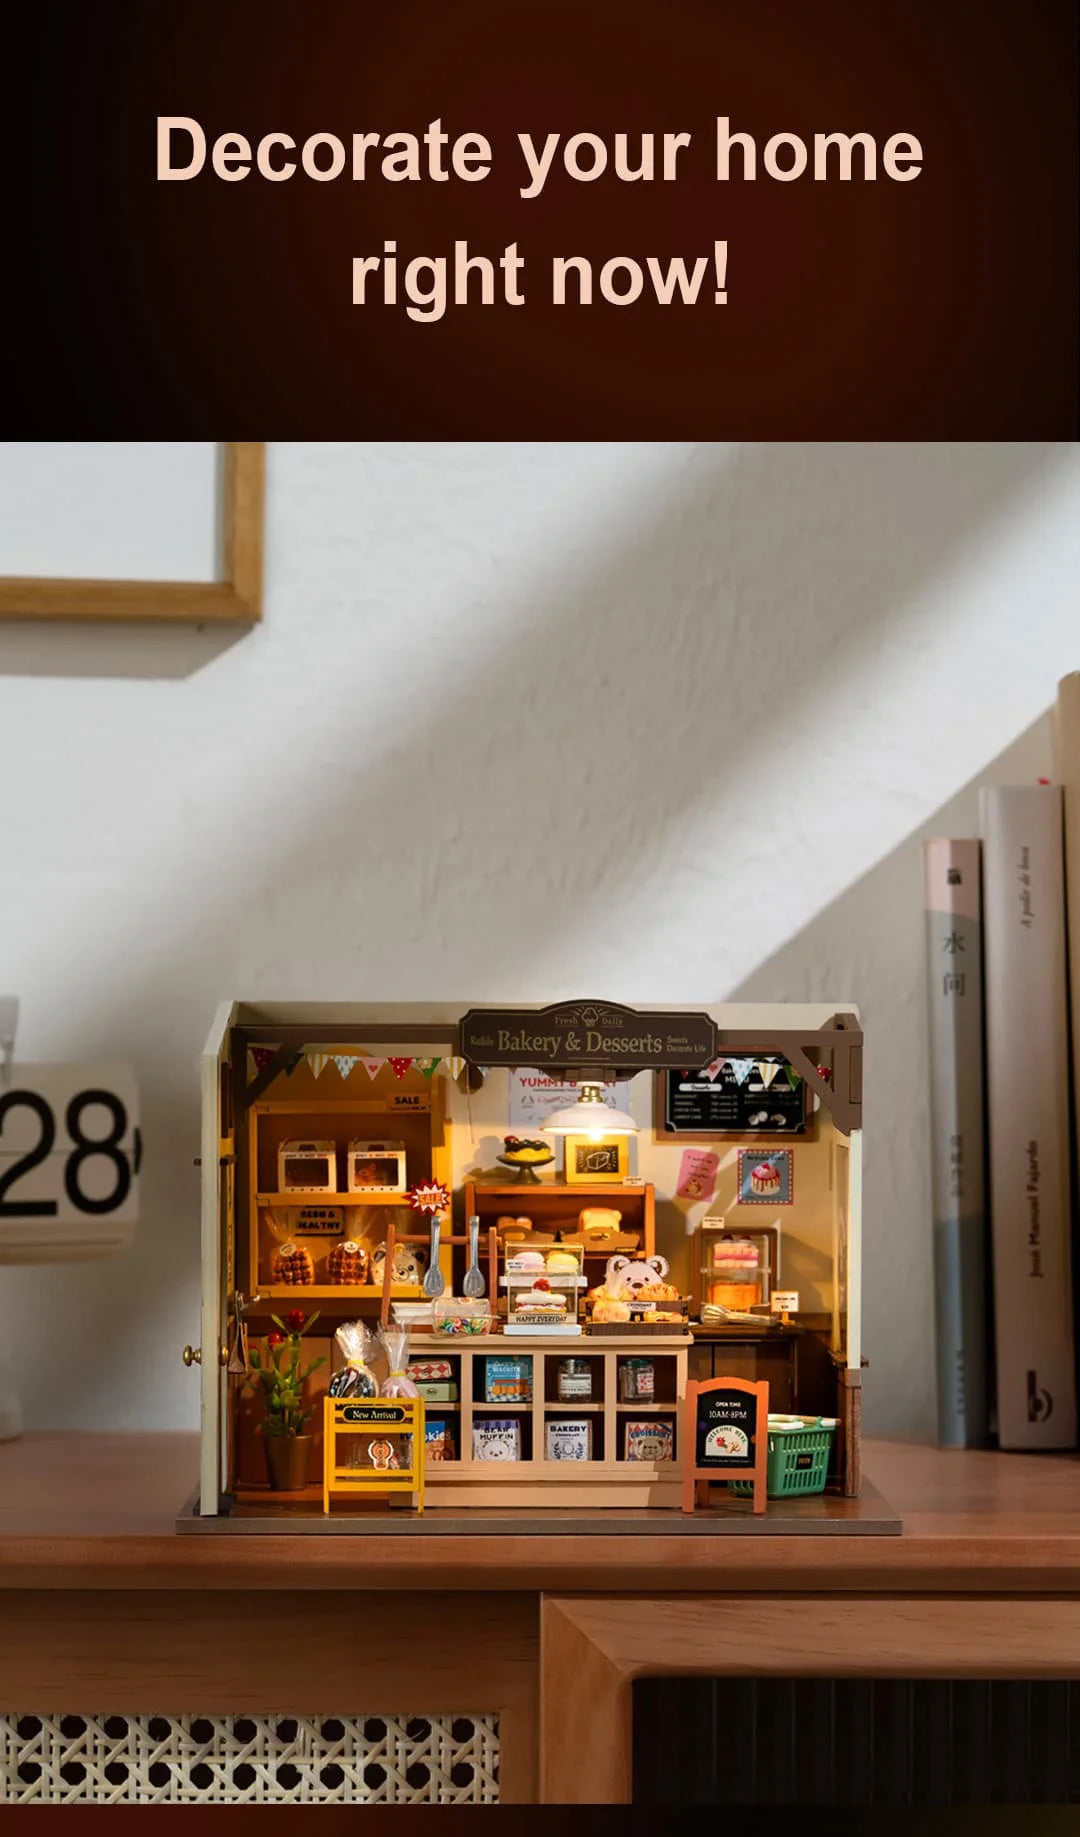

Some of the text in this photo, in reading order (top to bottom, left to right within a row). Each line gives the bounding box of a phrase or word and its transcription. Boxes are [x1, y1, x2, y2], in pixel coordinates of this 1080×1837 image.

[498, 1030, 561, 1057] Bakery
[565, 1031, 580, 1052] &
[586, 1031, 662, 1054] Desserts
[394, 1096, 420, 1105] SALE
[0, 1089, 131, 1216] 28
[1026, 1140, 1041, 1192] Fajardo
[1027, 1195, 1041, 1246] Manuel
[516, 1315, 536, 1323] HAPPY
[352, 1410, 396, 1420] New Arrival
